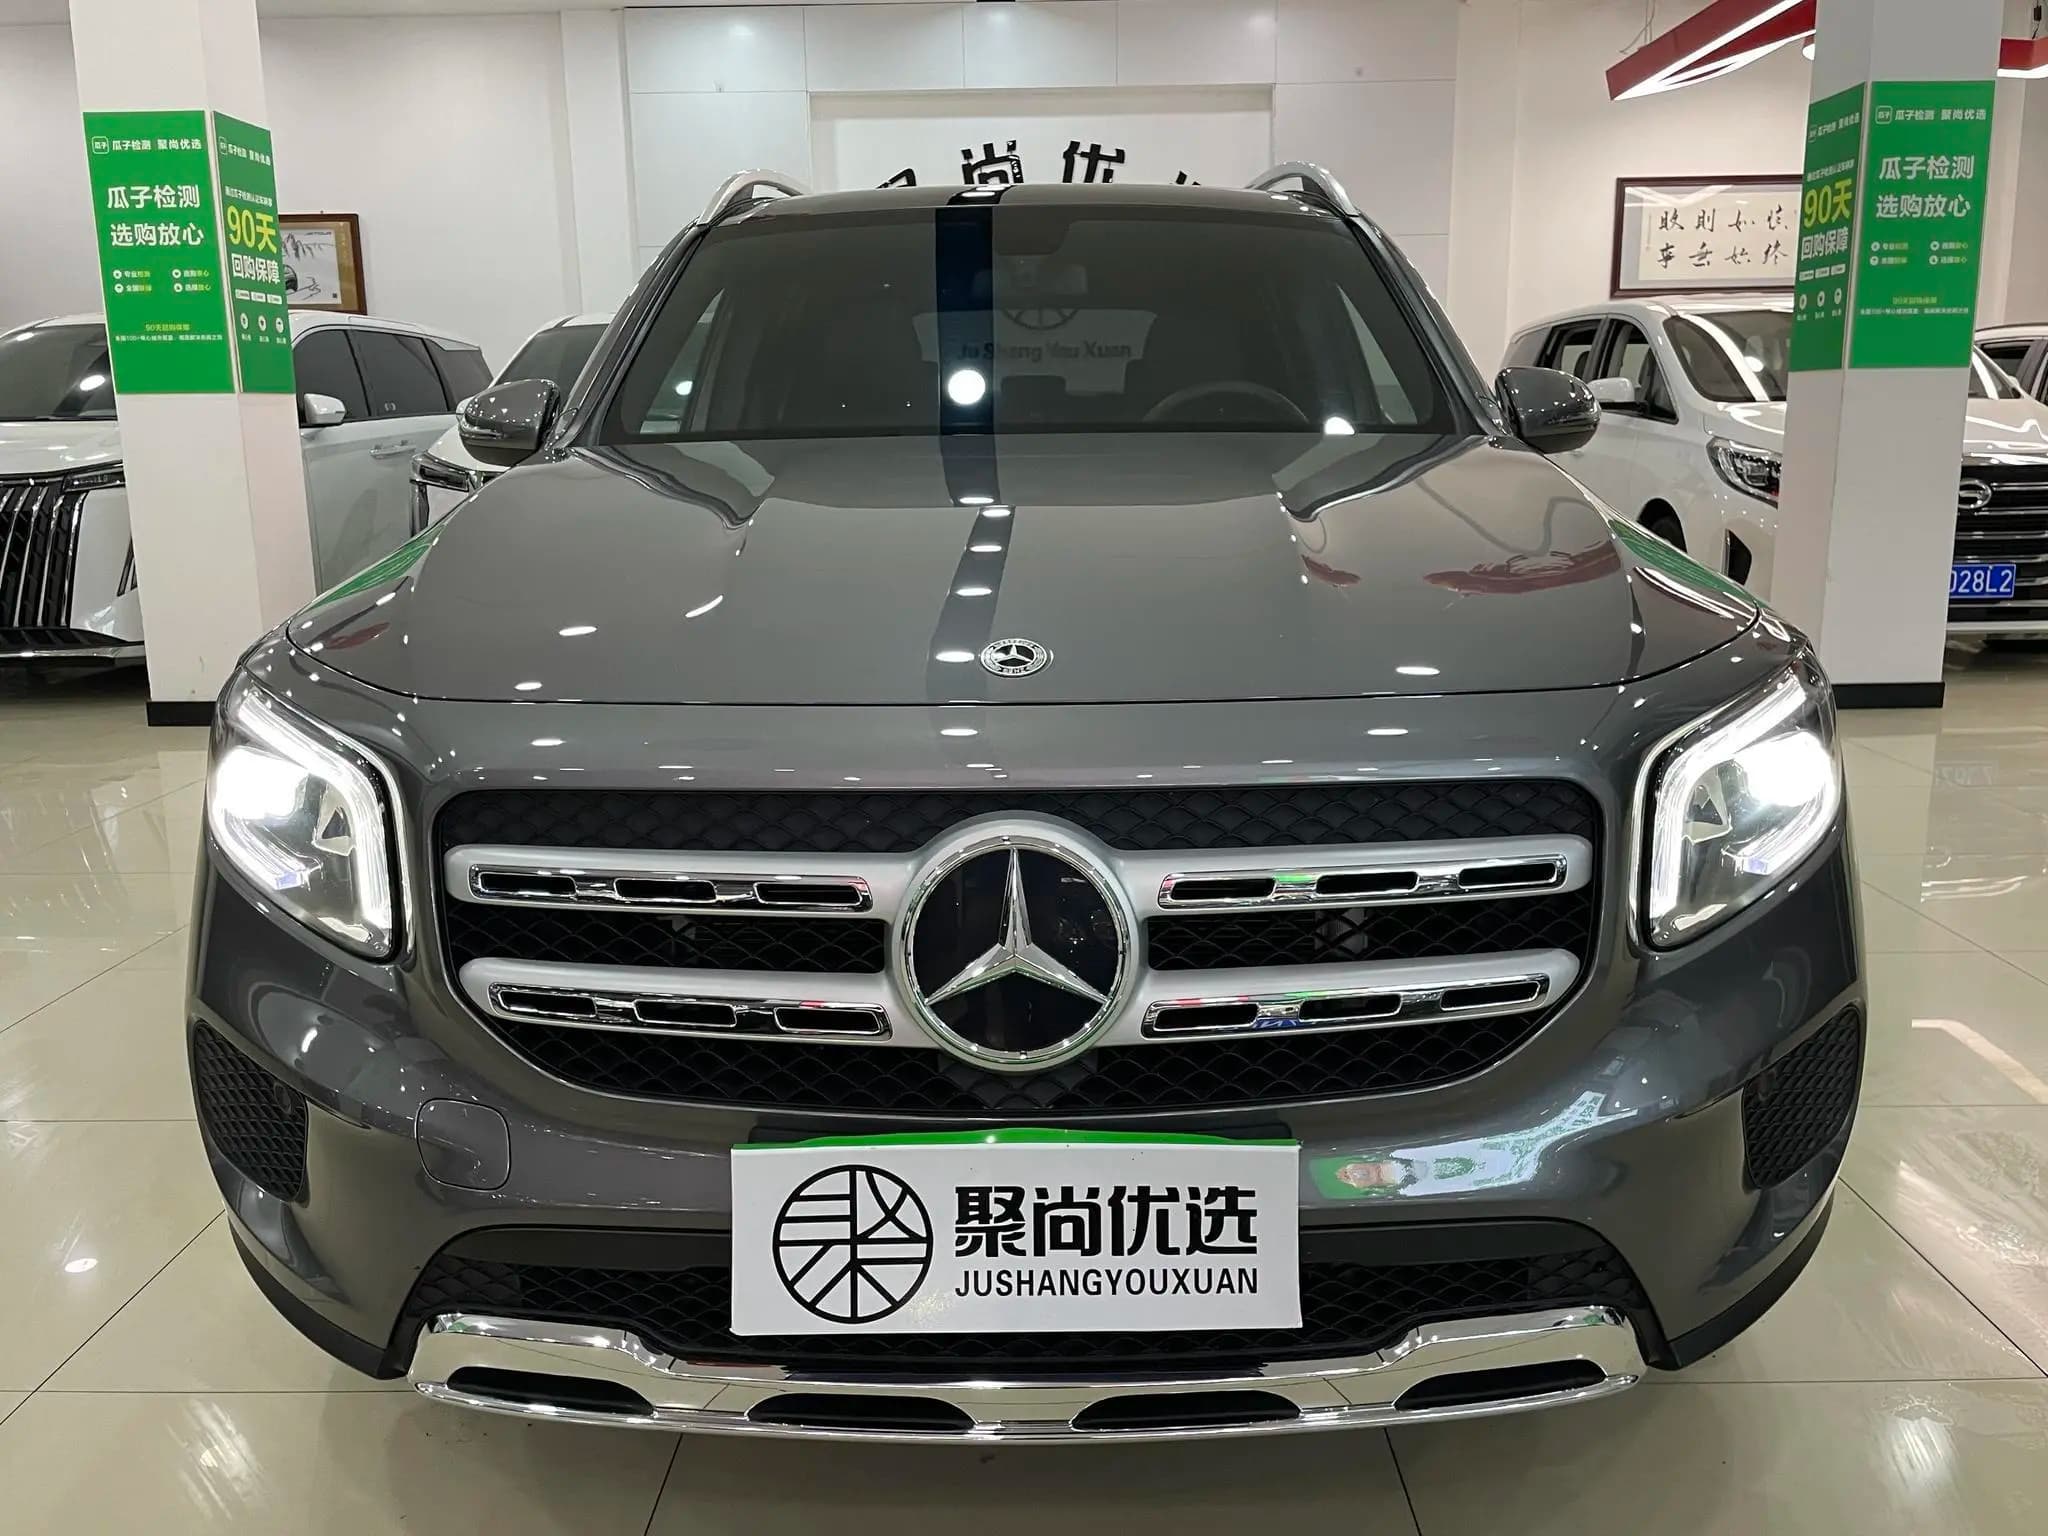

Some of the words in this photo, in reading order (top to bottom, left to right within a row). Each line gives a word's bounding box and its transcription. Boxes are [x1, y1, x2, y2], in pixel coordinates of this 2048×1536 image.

[1894, 109, 1935, 121] 瓜子检测
[1941, 108, 1986, 121] 聚尚优选
[112, 139, 152, 151] 瓜子检测
[157, 138, 202, 150] 聚尚优选
[1879, 155, 1975, 180] 瓜子检测
[107, 184, 201, 209] 瓜子检测
[1803, 177, 1853, 229] 90天
[1875, 194, 1972, 219] 选购放心
[110, 222, 204, 247] 选购放心
[226, 205, 277, 253] 90天
[1800, 226, 1849, 261] 回购保障
[231, 252, 281, 284] 回购保障
[954, 1185, 1258, 1258] 聚尚优选
[954, 1267, 1258, 1298] JUSHANGYOUXUAN
